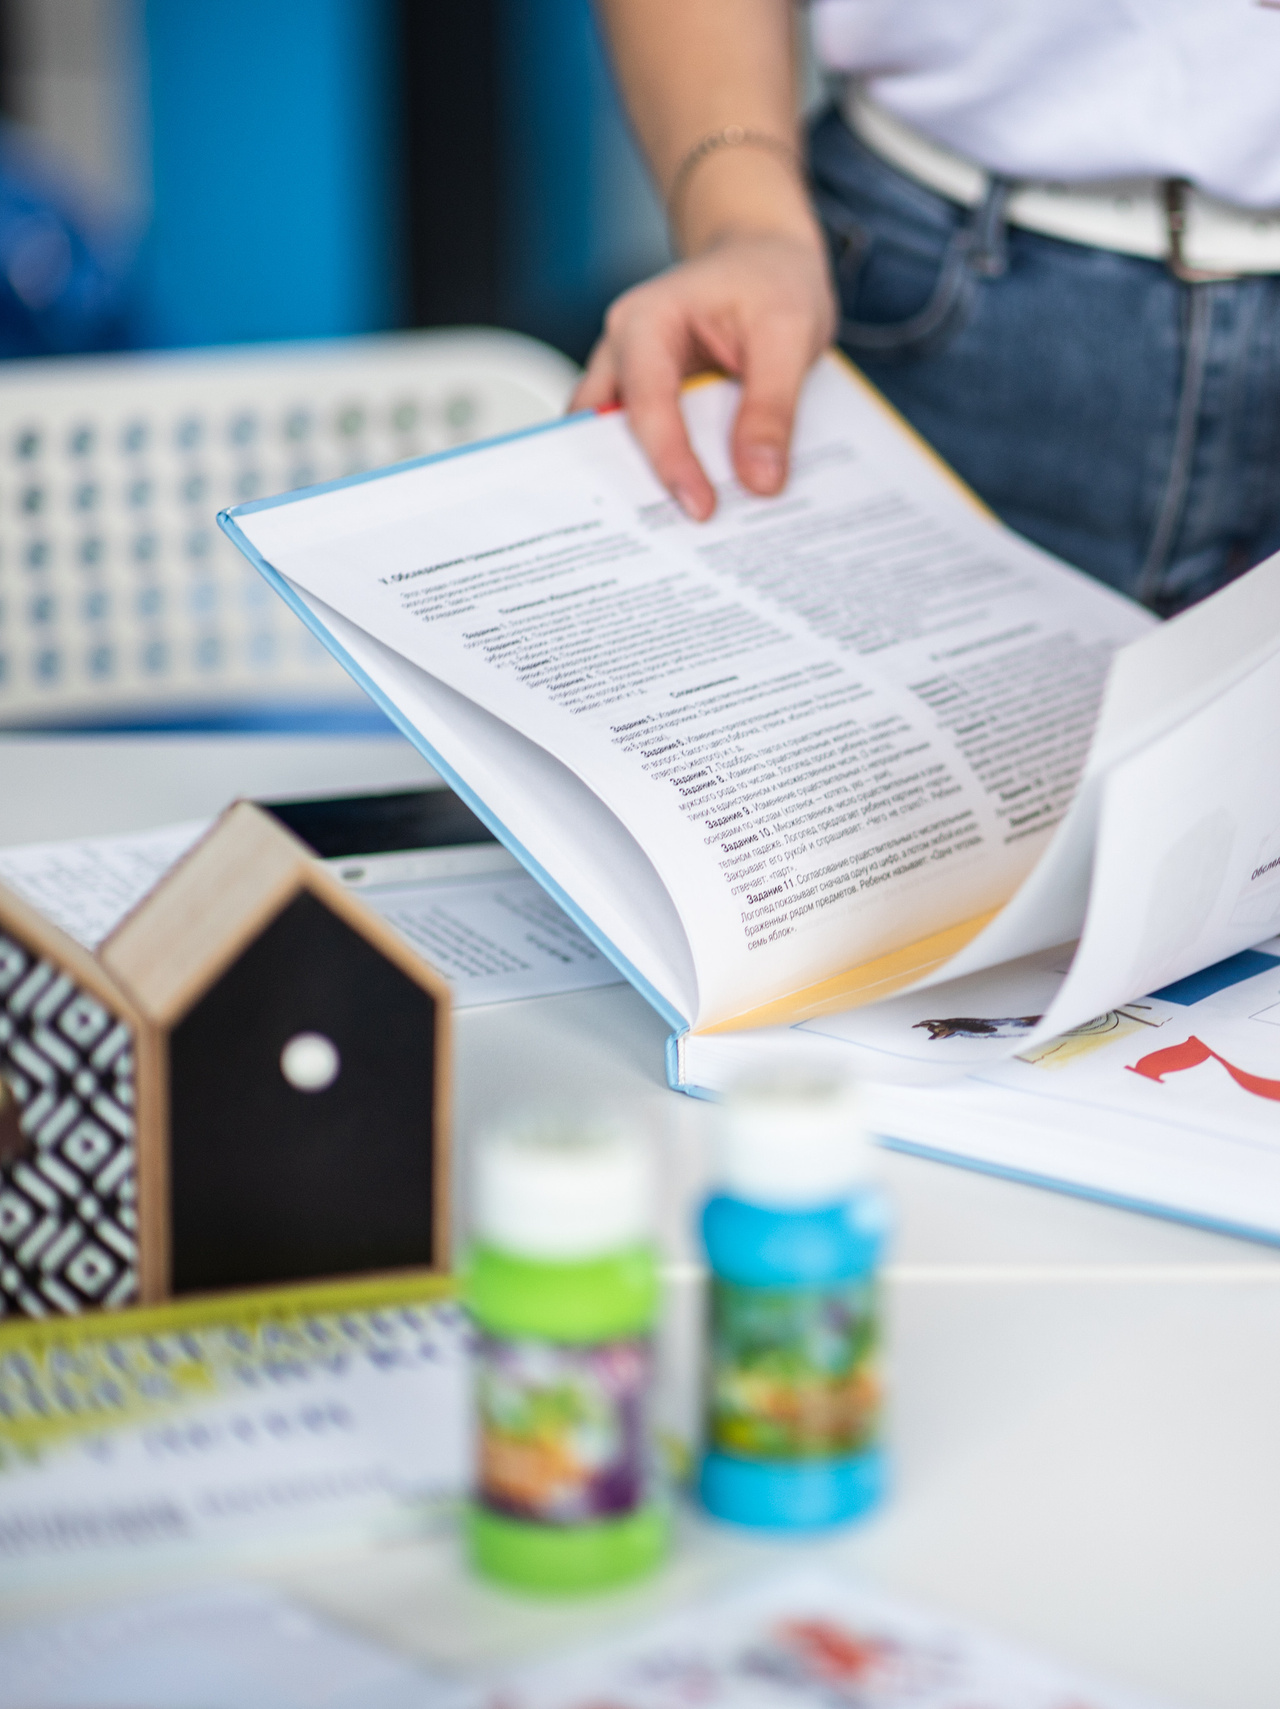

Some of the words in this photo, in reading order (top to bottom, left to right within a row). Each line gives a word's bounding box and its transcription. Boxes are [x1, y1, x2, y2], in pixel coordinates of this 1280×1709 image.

[610, 718, 648, 732] Задание
[641, 742, 678, 758] Задание
[681, 743, 708, 756] Какого
[651, 765, 686, 780] ответить
[670, 770, 708, 786] Задание
[716, 753, 759, 770] Подобрать
[679, 780, 717, 796] Задание
[727, 761, 766, 779] Изменить
[679, 793, 716, 811] мужского
[717, 785, 736, 798] рода
[748, 771, 776, 785] числам.
[778, 760, 811, 775] Логопед
[687, 809, 709, 821] тинки
[716, 787, 770, 811] единственном
[777, 763, 836, 789] множественном
[705, 810, 743, 829] Задание
[742, 806, 754, 815] 9.
[752, 791, 796, 810] Изменение
[704, 826, 741, 845] основами
[741, 821, 753, 830] по
[753, 810, 780, 825] числам
[718, 852, 752, 869] тельном
[752, 839, 784, 857] падеже.
[783, 826, 818, 844] Логопед
[817, 809, 860, 830] предлагает
[721, 834, 759, 852] Задание
[758, 827, 774, 838] 10.
[773, 806, 835, 832] Множественное
[835, 797, 857, 809] число
[724, 860, 768, 882] Закрывает
[769, 854, 784, 865] его
[784, 843, 807, 861] рукой
[815, 823, 865, 846] спрашивает:
[866, 813, 888, 826] «Чего
[731, 875, 769, 896] отвечает:
[769, 865, 797, 880] «парт».
[741, 904, 775, 923] Логопед
[774, 885, 818, 910] показывает
[819, 873, 850, 891] сначала
[850, 866, 868, 880] одну
[879, 853, 901, 867] цифр,
[907, 841, 929, 855] потом
[746, 884, 784, 905] Задание
[784, 878, 798, 890] 11.
[797, 858, 849, 884] Согласование
[849, 833, 912, 864] существительных
[744, 913, 788, 937] браженных
[790, 903, 814, 920] рядом
[815, 886, 859, 908] предметов.
[860, 872, 892, 890] Ребенок
[893, 857, 928, 876] называет:
[748, 937, 768, 951] семь
[769, 927, 797, 943] яблок».
